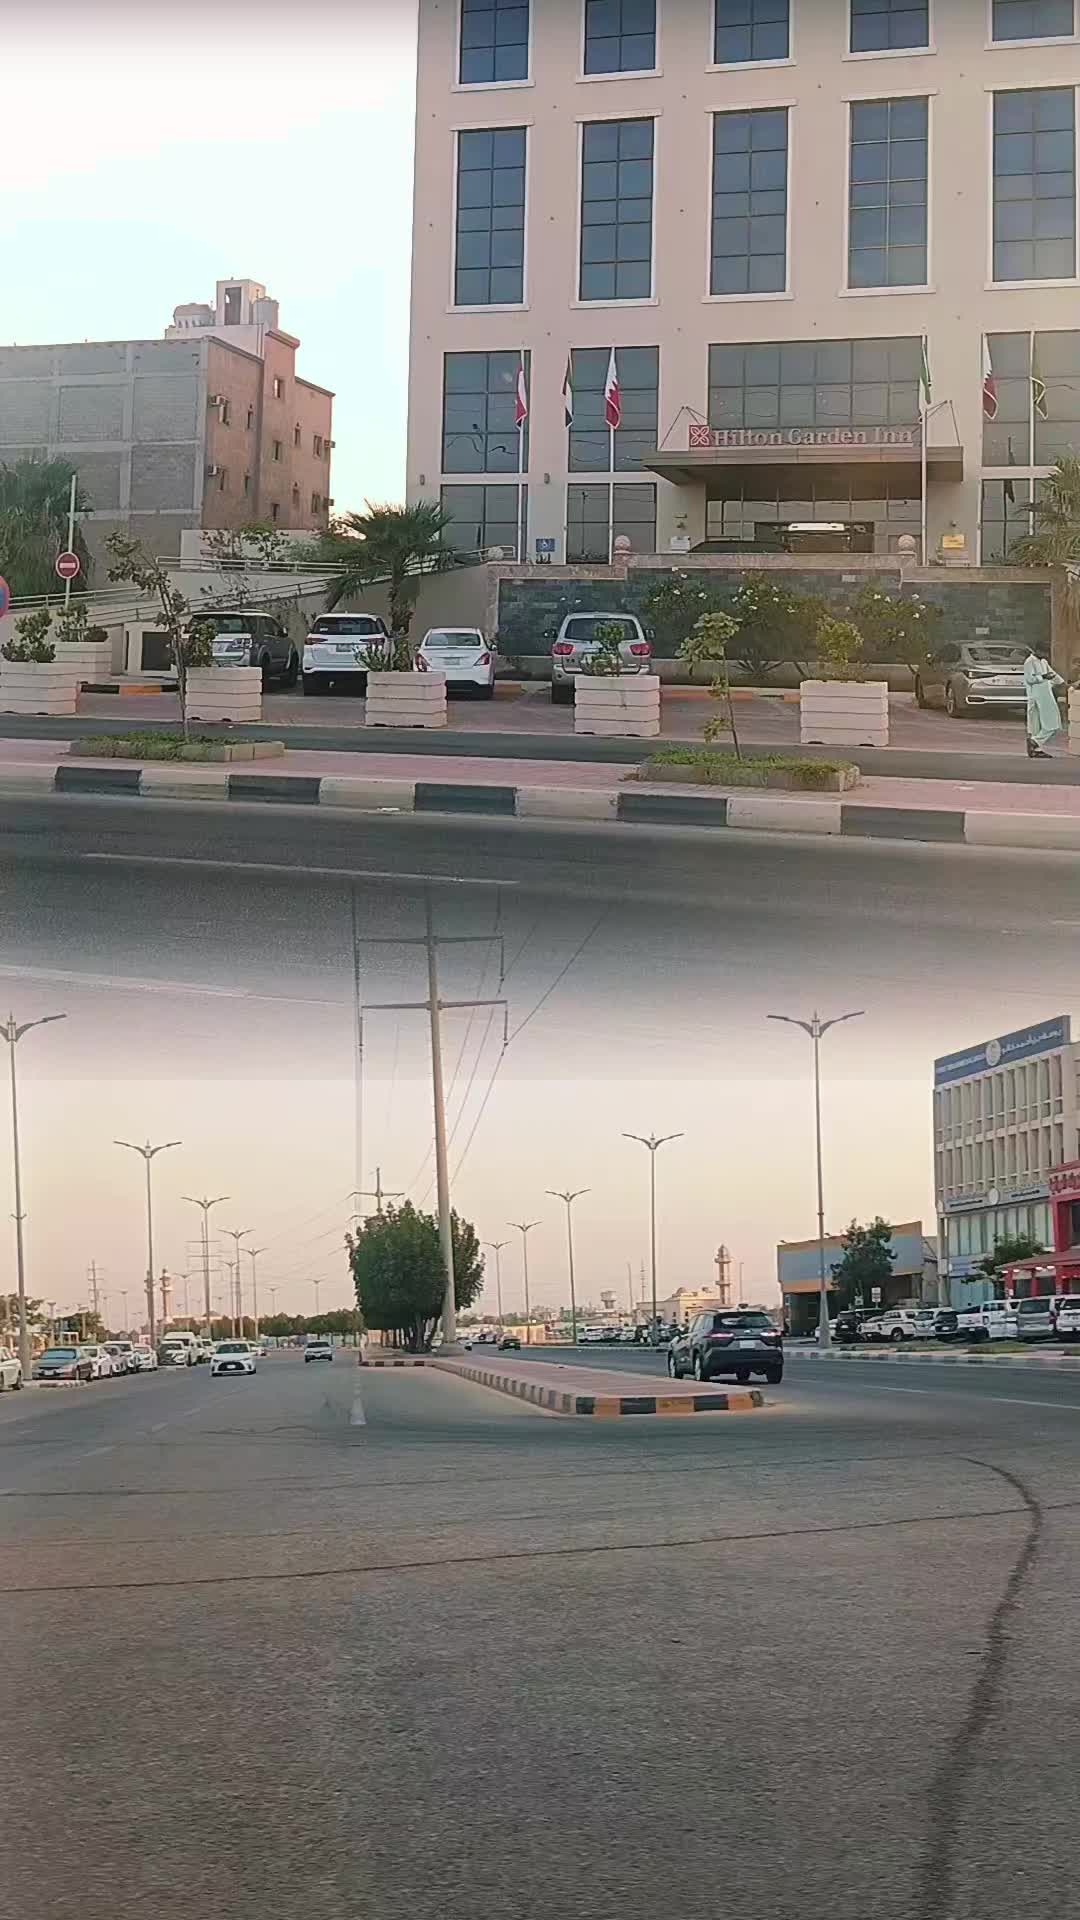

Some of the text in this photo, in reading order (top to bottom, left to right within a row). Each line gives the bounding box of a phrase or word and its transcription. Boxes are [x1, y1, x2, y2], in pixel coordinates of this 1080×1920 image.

[714, 427, 913, 445] Hilton Garden Inn
